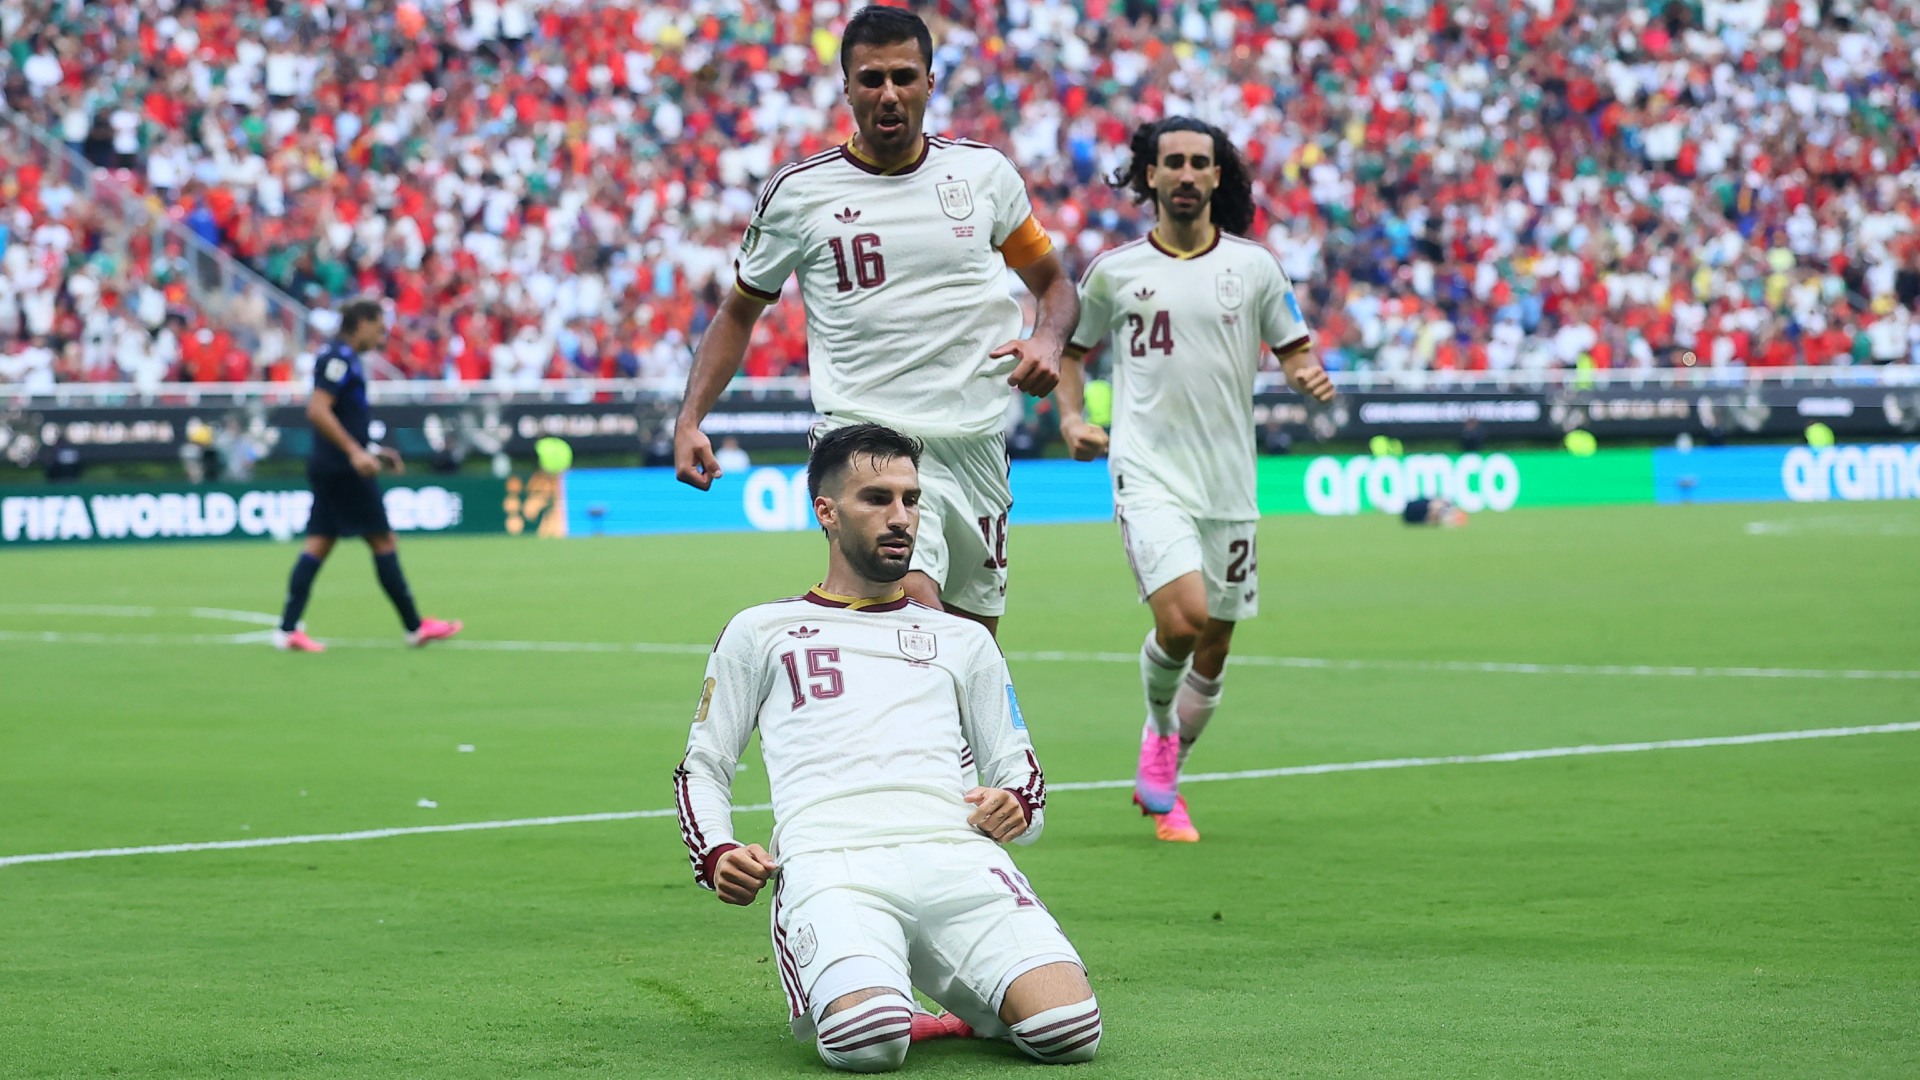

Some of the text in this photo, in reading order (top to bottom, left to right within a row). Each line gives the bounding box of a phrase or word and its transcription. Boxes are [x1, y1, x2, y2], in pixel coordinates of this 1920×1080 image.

[828, 233, 886, 292] 16
[1129, 310, 1174, 357] 24
[1305, 453, 1520, 515] aramco
[2, 495, 93, 542] FIFA
[92, 492, 237, 540] WORLD
[780, 648, 845, 711] 15
